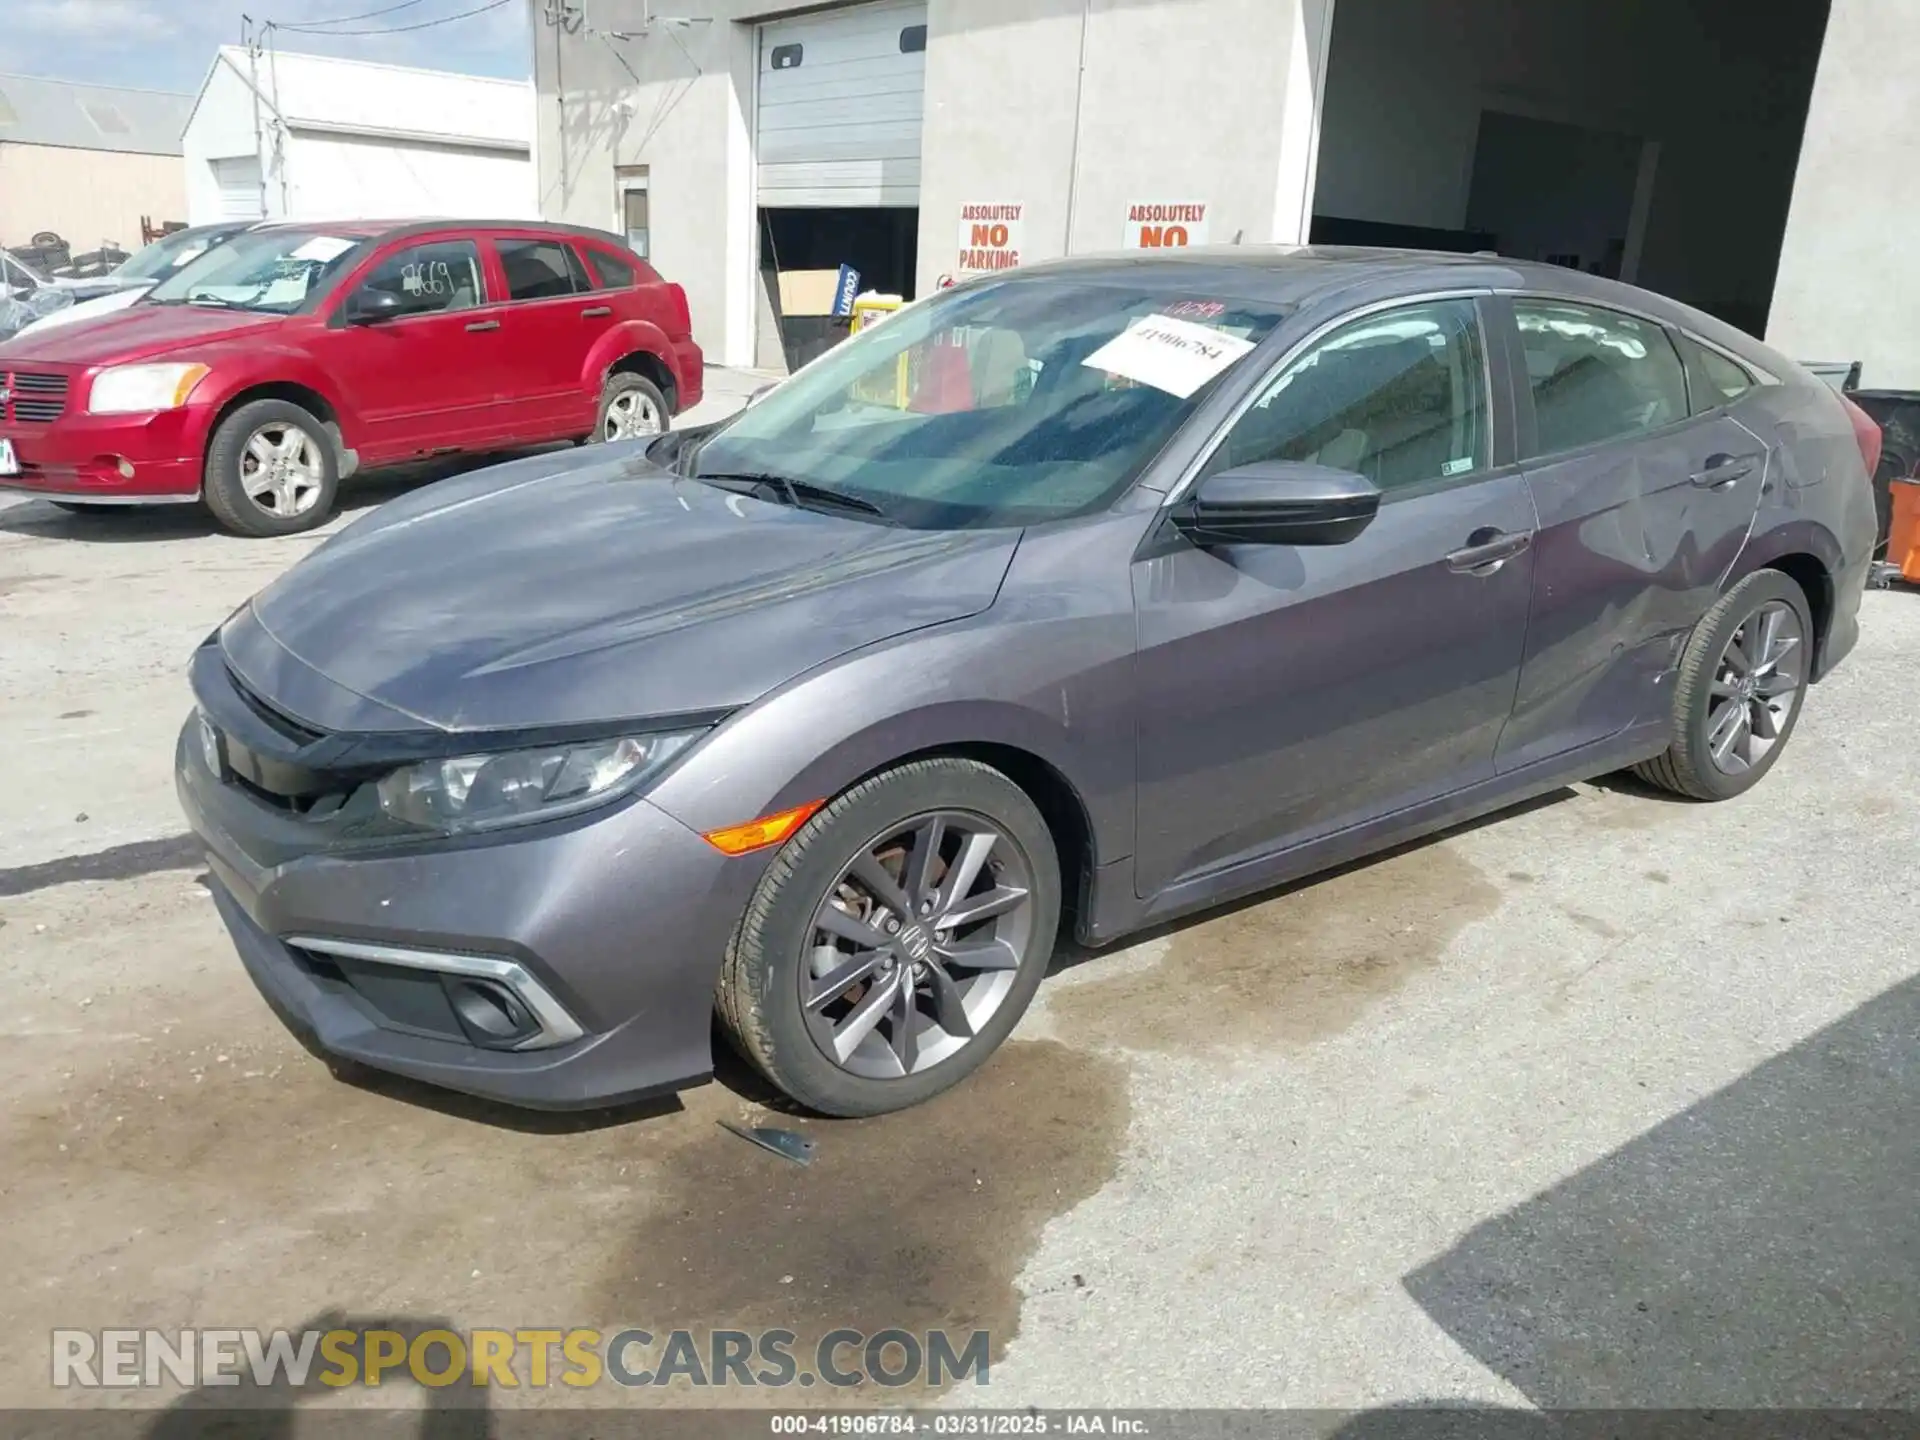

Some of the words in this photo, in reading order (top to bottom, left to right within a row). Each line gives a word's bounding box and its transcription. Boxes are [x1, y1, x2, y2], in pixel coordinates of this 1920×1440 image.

[962, 204, 1021, 221] ABSOLUTELY
[1128, 204, 1206, 222] ABSOLUTELY
[971, 223, 1009, 247] NO
[1140, 225, 1188, 248] NO
[959, 249, 1019, 270] PARKING
